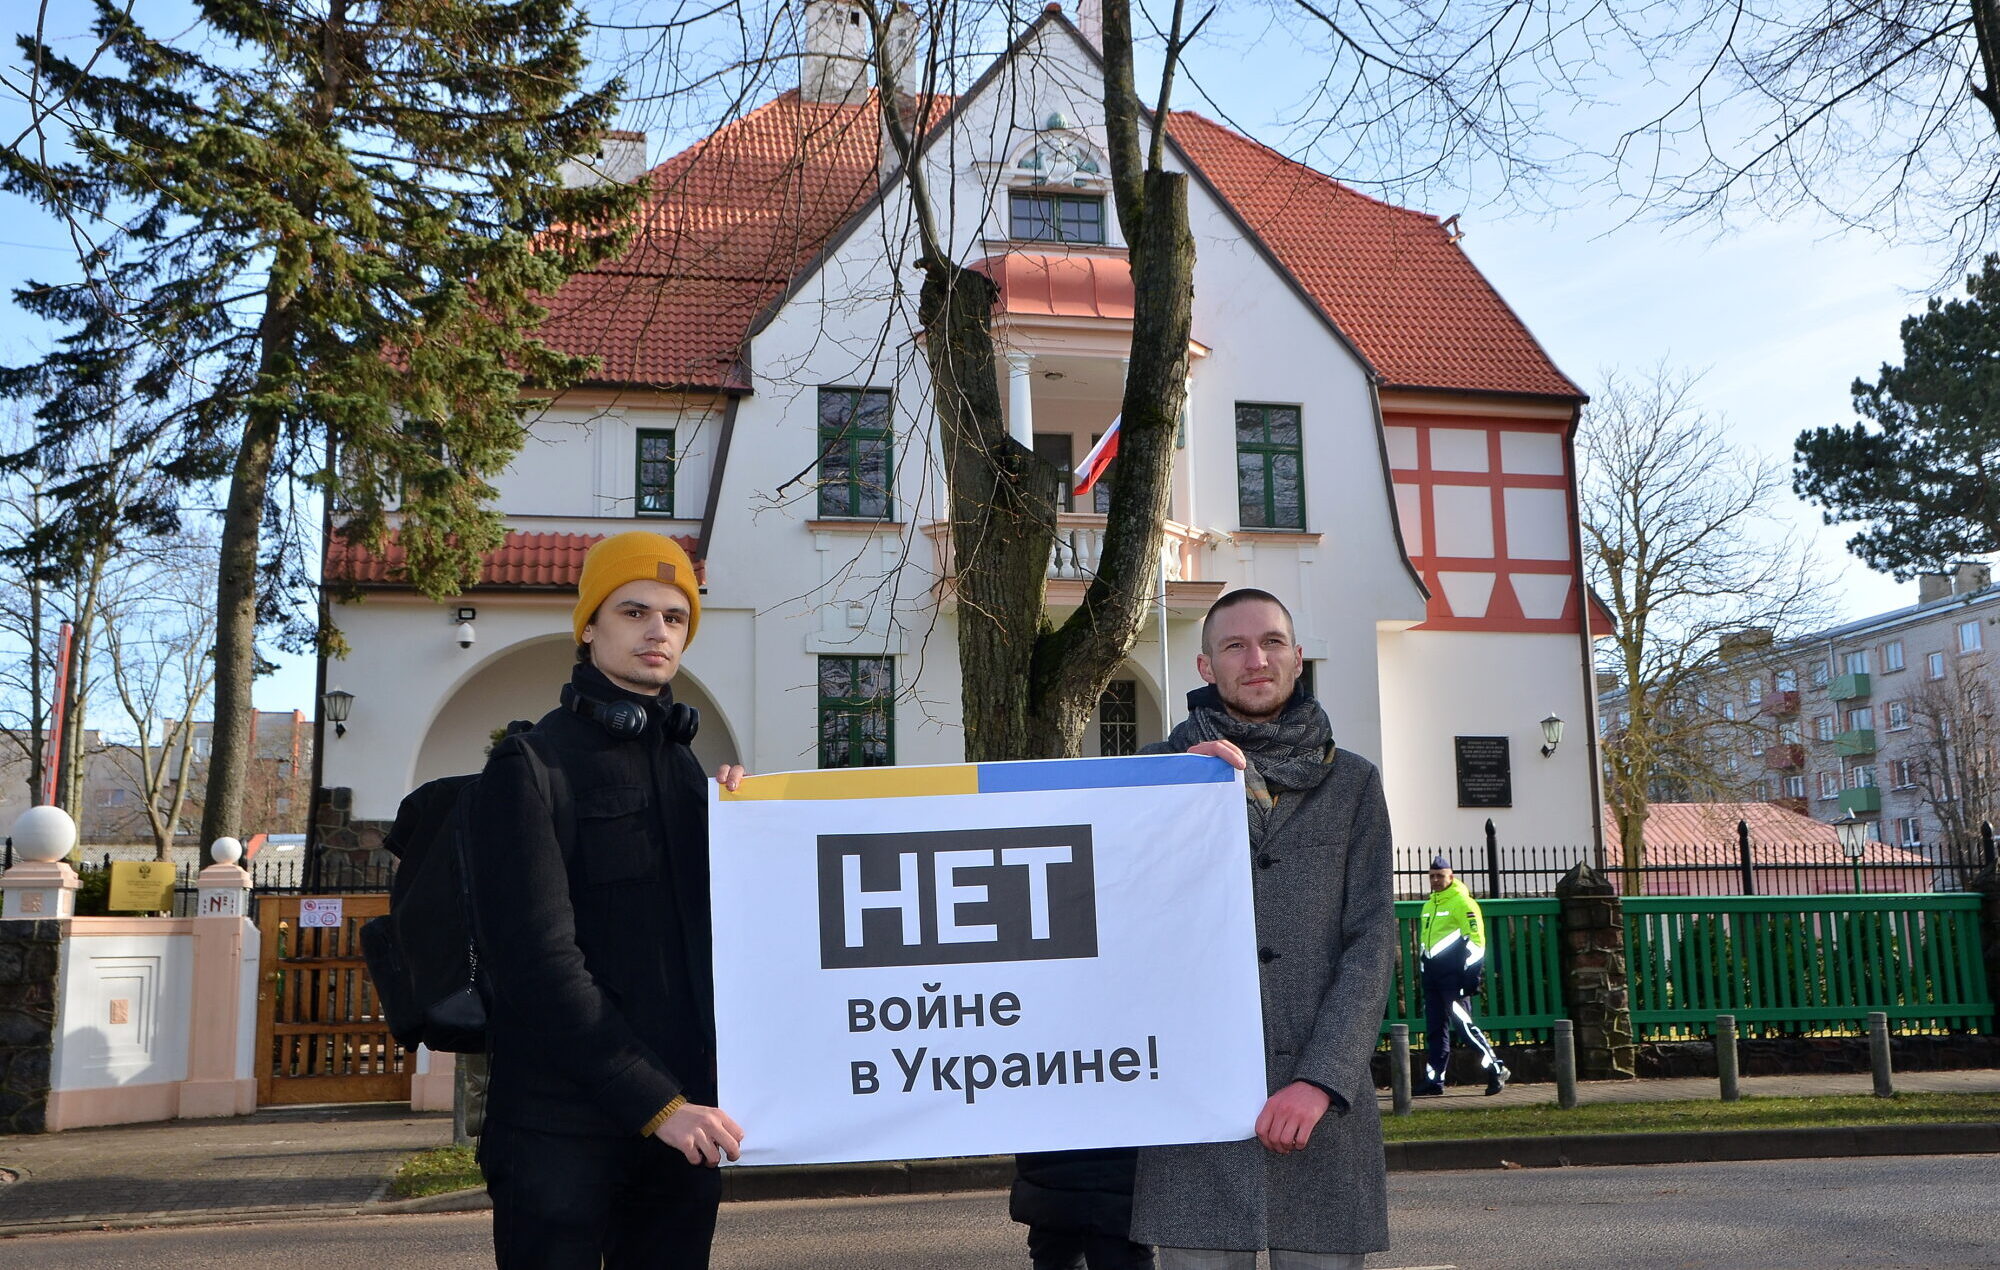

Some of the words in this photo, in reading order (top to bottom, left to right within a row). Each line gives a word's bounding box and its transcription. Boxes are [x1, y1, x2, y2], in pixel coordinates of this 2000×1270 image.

[612, 711, 628, 730] JBL
[842, 845, 1073, 948] НЕТ
[847, 982, 1021, 1033] войне
[850, 1060, 880, 1095] в
[891, 1035, 1159, 1105] Украине!
